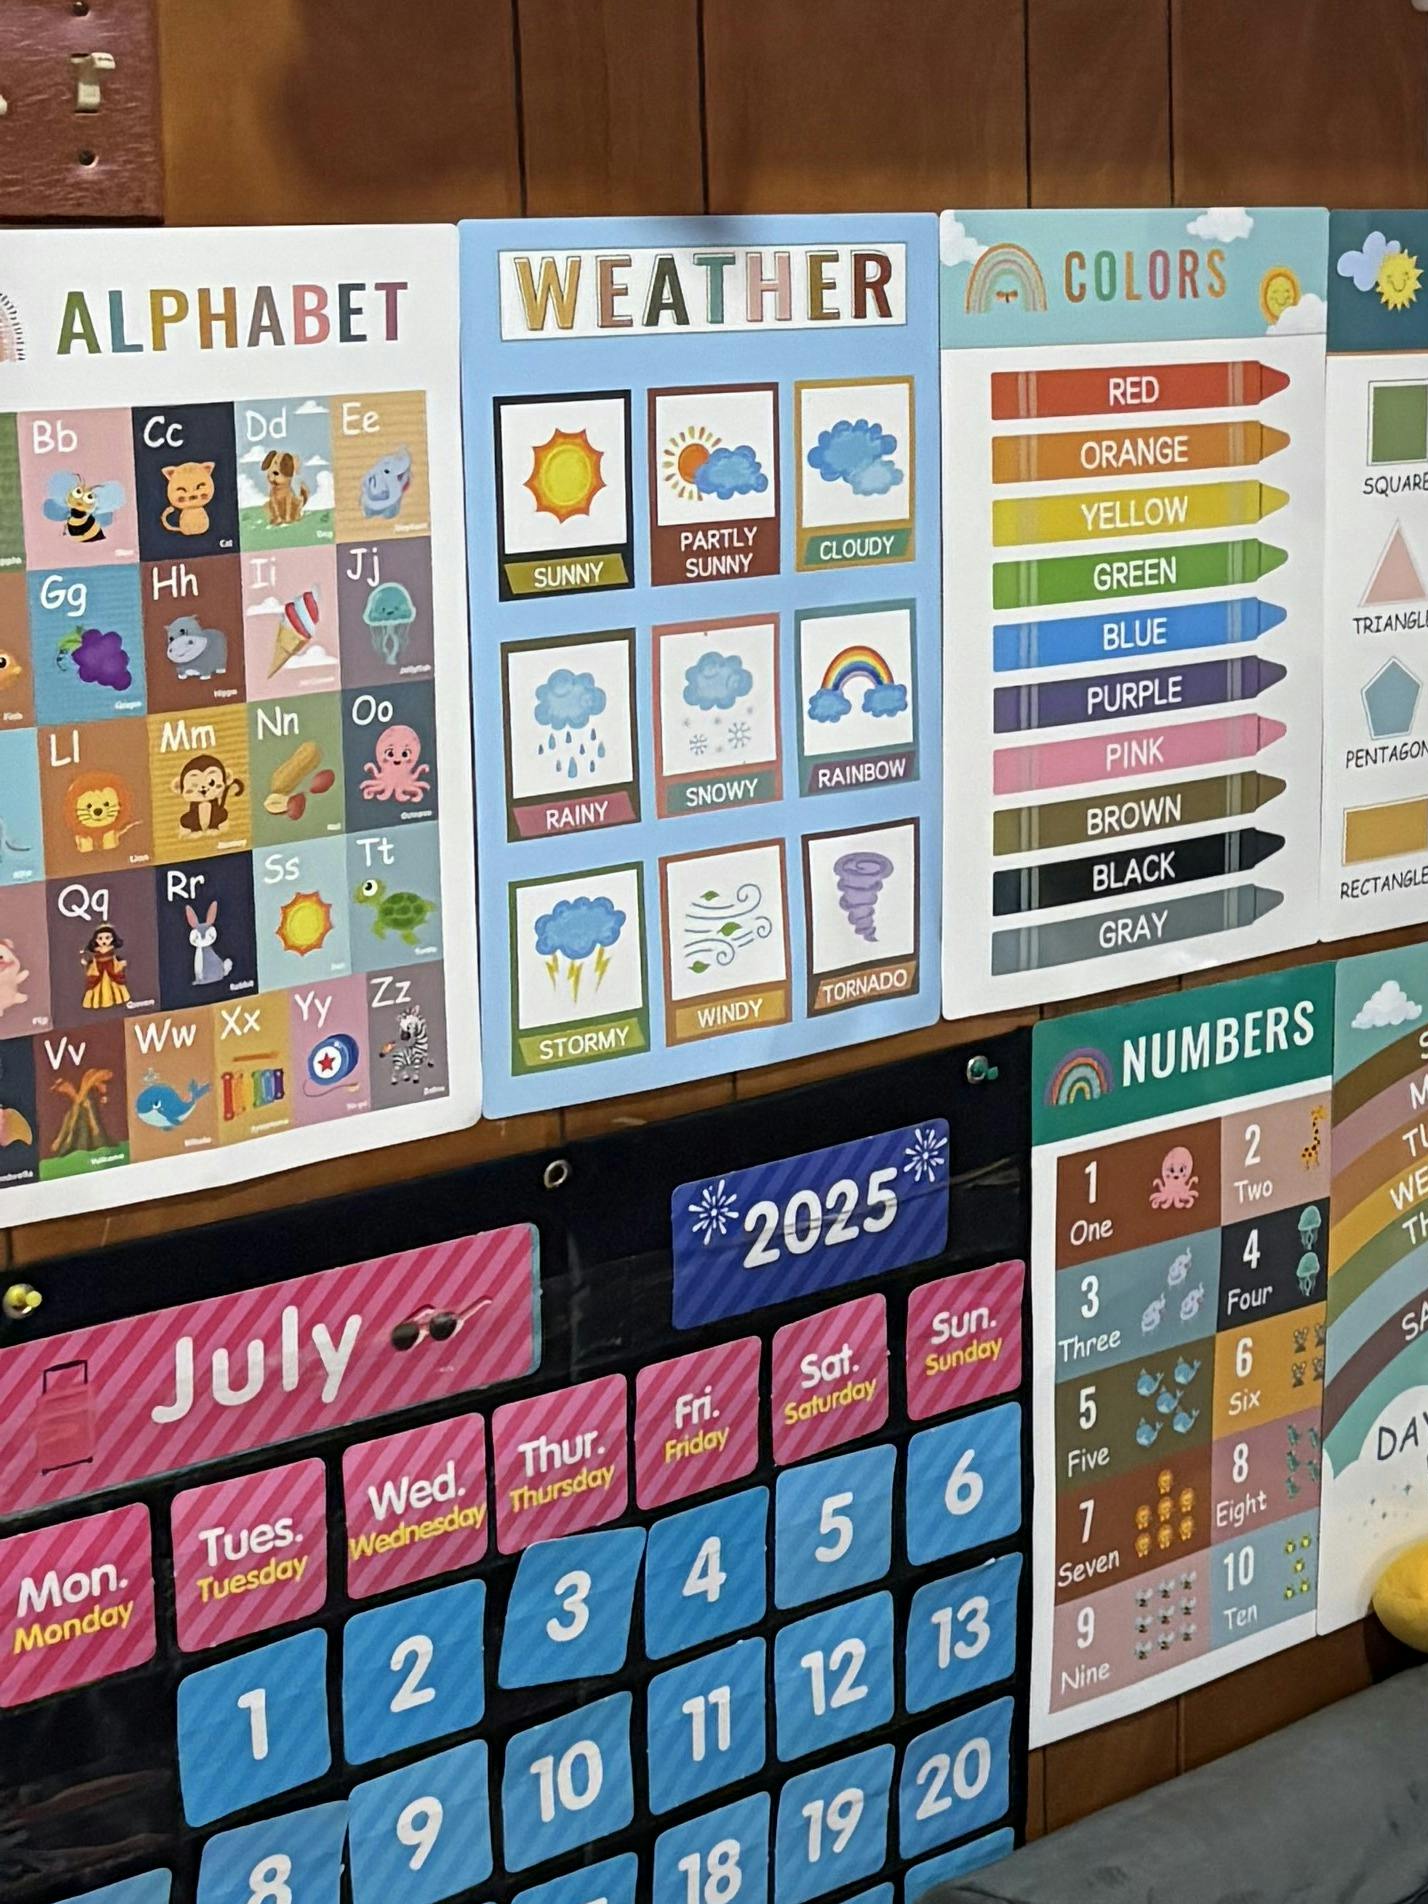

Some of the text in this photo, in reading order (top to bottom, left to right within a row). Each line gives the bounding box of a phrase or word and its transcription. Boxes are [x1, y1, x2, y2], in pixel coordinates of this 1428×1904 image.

[513, 249, 893, 332] WEATHER
[1064, 249, 1227, 304] COLORS
[56, 281, 409, 355] ALPHABET
[1109, 376, 1160, 406] RED
[32, 419, 78, 455] Bb
[143, 415, 184, 448] Cc
[1080, 435, 1189, 470] ORANGE
[1080, 496, 1189, 532] YELLOW
[680, 526, 758, 551] PARTLY
[818, 535, 896, 561] CLOUDY
[534, 560, 604, 588] SUNNY
[685, 553, 753, 580] SUNNY
[1103, 617, 1168, 650] BLUE
[817, 758, 906, 789] RAINBOW
[685, 778, 758, 808] SNOWY
[546, 802, 608, 830] RAINY
[823, 969, 908, 1002] TORNADO
[697, 998, 763, 1028] WINDY
[539, 1026, 630, 1060] STORMY
[1122, 999, 1315, 1088] NUMBERS
[1233, 1179, 1273, 1205] Two
[740, 1166, 900, 1271] 2025
[1070, 1217, 1114, 1247] One
[148, 1303, 364, 1425] July
[923, 1330, 1003, 1381] Sunday
[782, 1376, 878, 1428] Saturday
[1228, 1389, 1261, 1417] Six
[663, 1423, 730, 1467] Friday
[508, 1458, 616, 1516] Thursday
[1215, 1489, 1268, 1529] Eight
[198, 1511, 305, 1569] Tues.
[347, 1498, 487, 1562] Wednesday
[195, 1551, 310, 1603] Tuesday
[12, 1598, 135, 1656] Monday
[928, 1593, 992, 1670] 13
